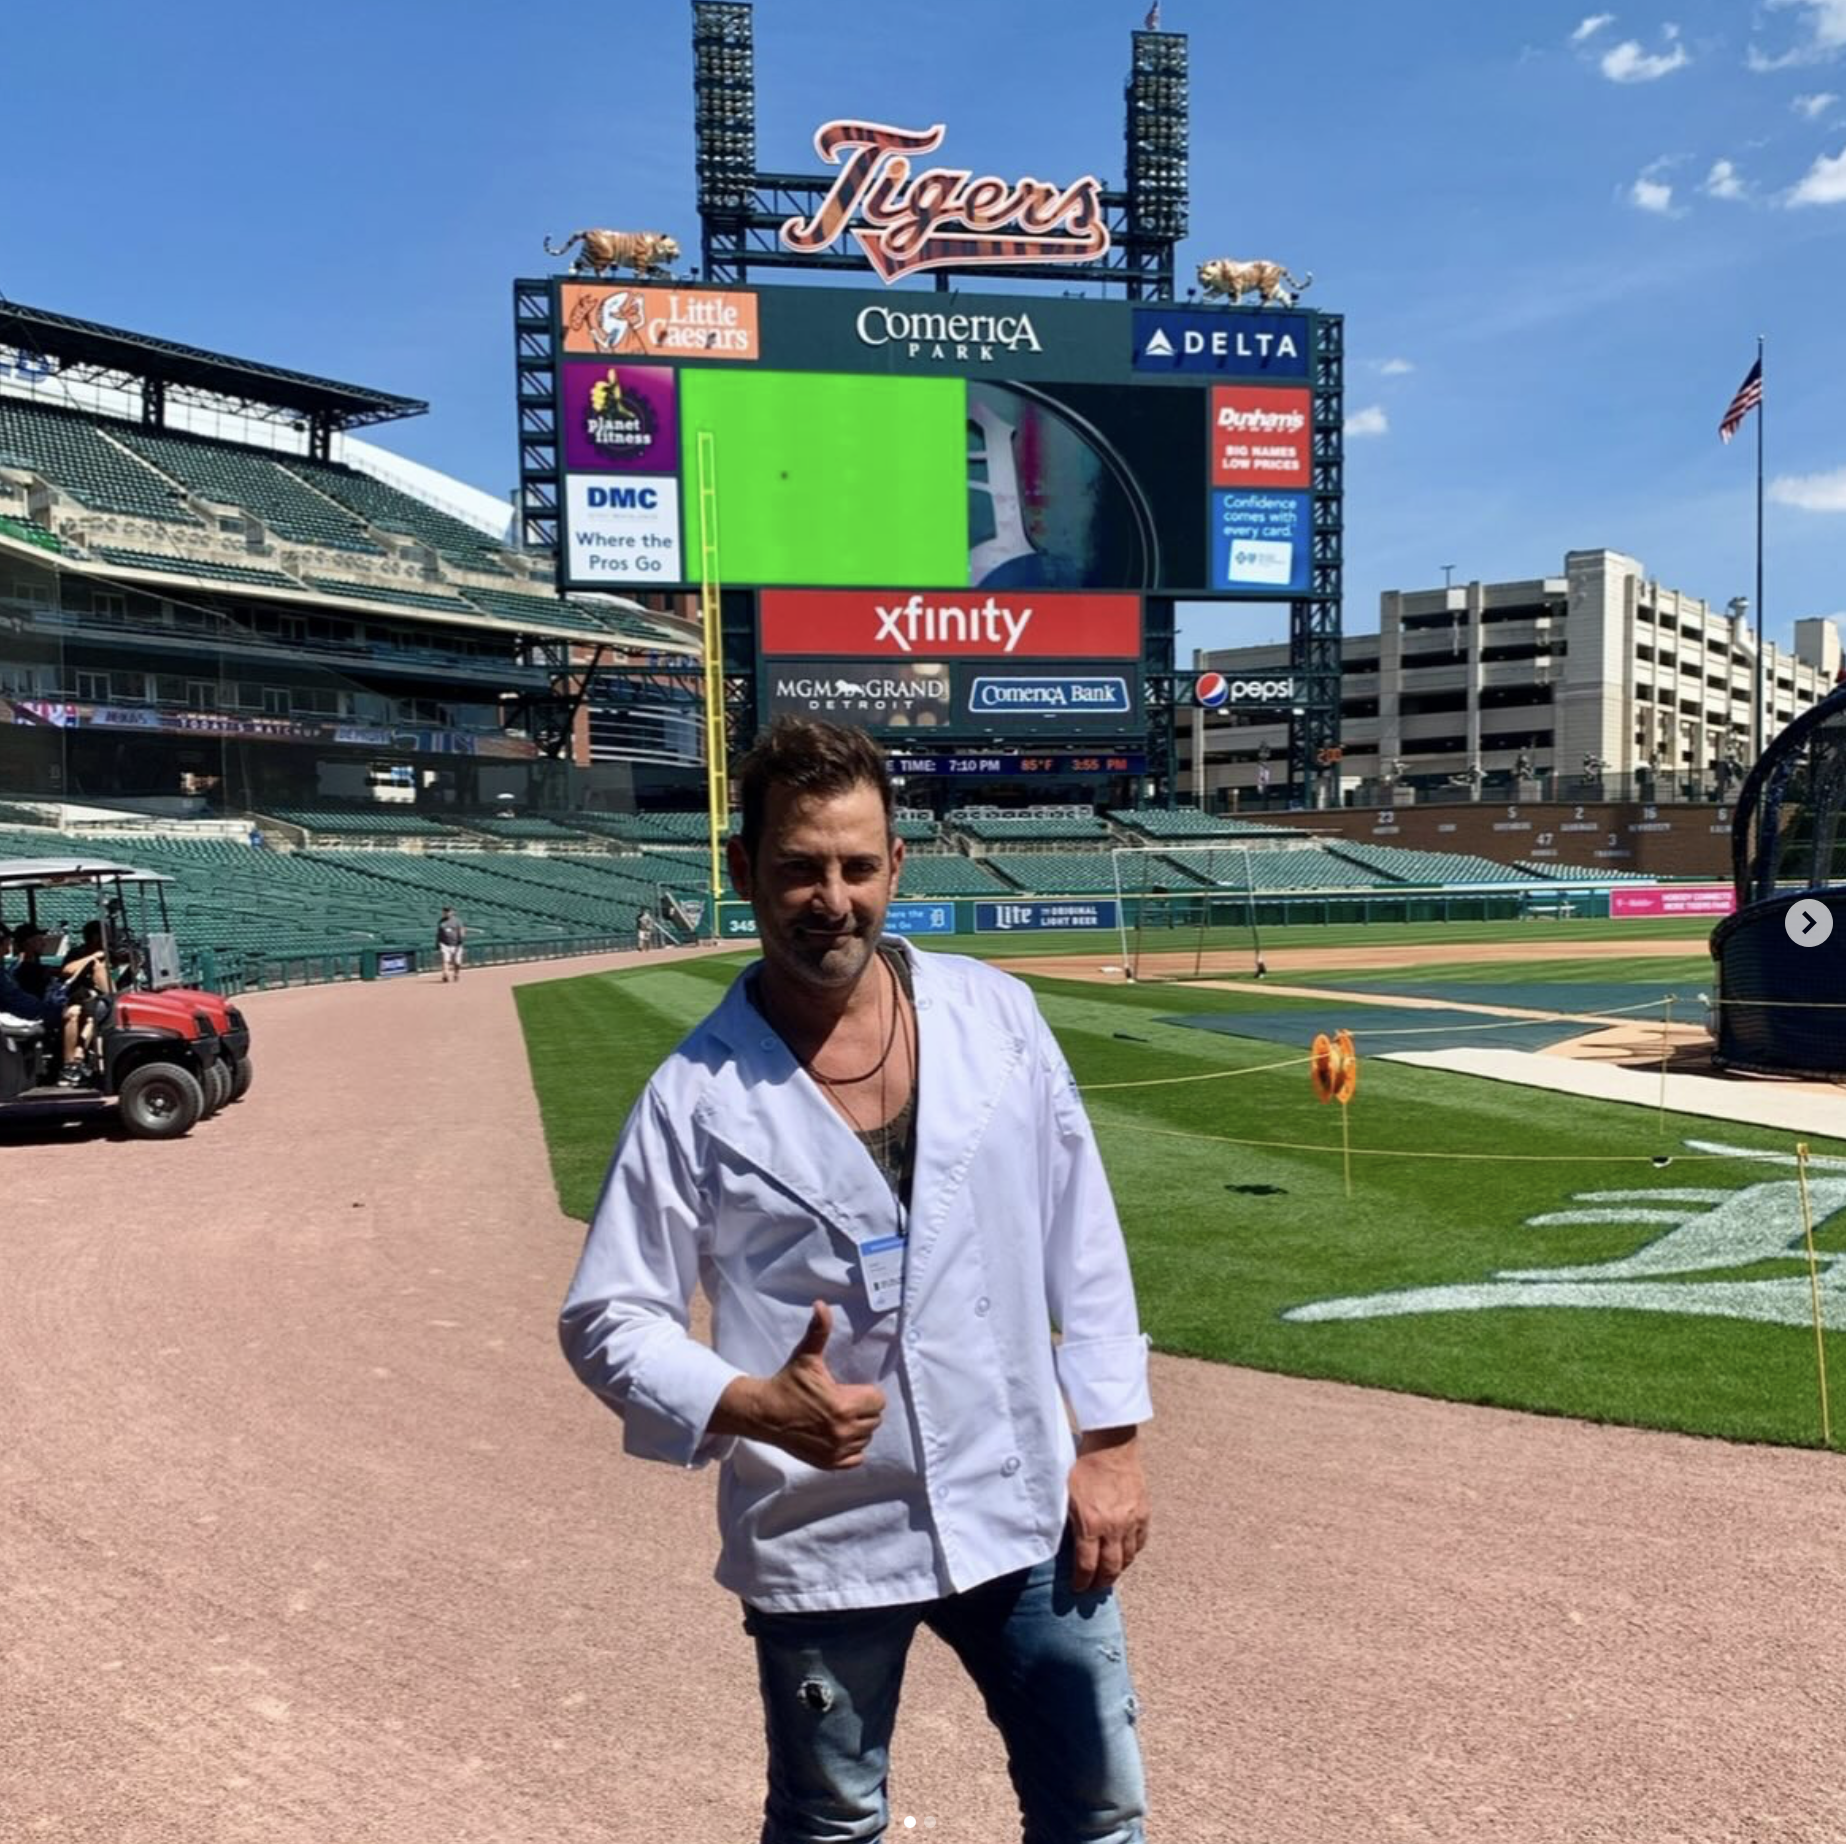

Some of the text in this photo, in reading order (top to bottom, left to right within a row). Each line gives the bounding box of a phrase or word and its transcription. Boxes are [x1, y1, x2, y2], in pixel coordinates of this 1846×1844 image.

[780, 119, 1110, 284] Tigers
[668, 293, 738, 326] Little
[647, 317, 750, 350] Caesars
[908, 342, 993, 361] PARK
[1184, 331, 1297, 357] DELTA
[587, 416, 641, 433] planet
[1217, 406, 1305, 428] Dunham's
[594, 431, 652, 445] fitness
[1225, 444, 1297, 458] BIG NAMES
[1222, 457, 1300, 471] LOW PRICES
[587, 486, 658, 510] DMC
[1223, 493, 1298, 510] Confidence
[1223, 510, 1297, 523] comes with
[576, 531, 673, 549] Where the
[1223, 526, 1259, 540] every
[589, 553, 662, 572] Pros Go
[874, 595, 1032, 652] xfinity
[776, 679, 943, 698] MGM GRAND
[1071, 684, 1117, 702] Bank
[1231, 677, 1294, 702] pepsi
[809, 700, 914, 710] DETROIT
[901, 759, 936, 771] TIME:
[950, 759, 977, 771] 7:10
[979, 759, 1000, 771] PM
[1107, 758, 1128, 770] PM
[1575, 807, 1585, 820] 2
[1536, 833, 1554, 846] 47
[884, 908, 906, 919] here
[996, 905, 1033, 929] Lite
[1051, 906, 1098, 915] ORIGINAL
[729, 919, 756, 932] 345
[1041, 916, 1098, 926] LIGHT BEER
